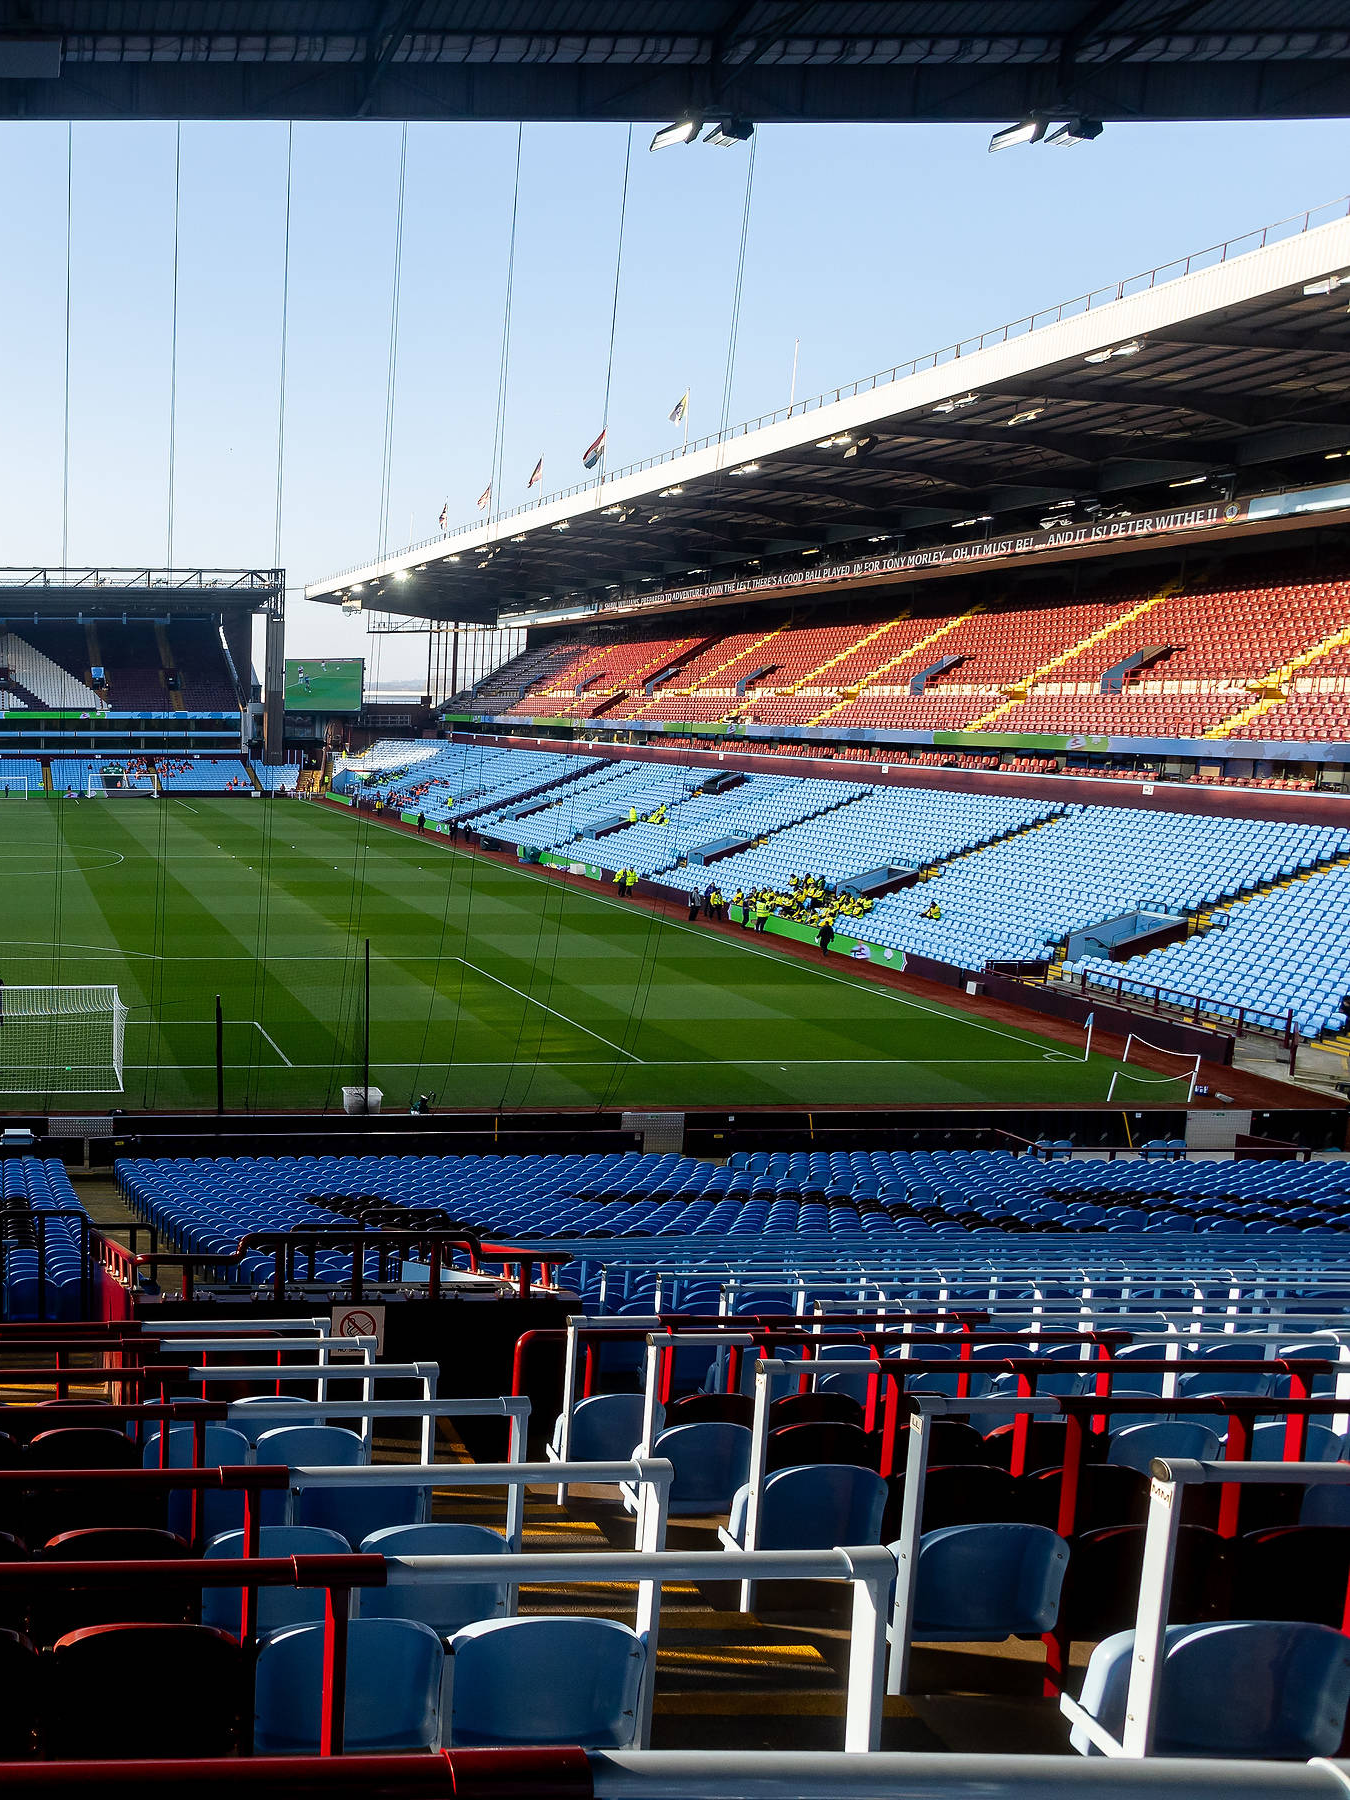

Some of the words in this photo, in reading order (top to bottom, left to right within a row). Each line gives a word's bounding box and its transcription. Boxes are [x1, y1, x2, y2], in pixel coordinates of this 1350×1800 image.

[672, 587, 703, 601] ADVENTURE
[724, 582, 736, 592] THE
[752, 576, 777, 588] THERE'S
[783, 571, 804, 584] GOOD
[805, 569, 822, 581] BALL
[822, 565, 850, 580] PLAYED
[853, 563, 863, 574] IN
[863, 560, 880, 573] FOR
[882, 556, 906, 570] TONY
[970, 545, 982, 558] IT
[983, 540, 1014, 556] MUST
[1015, 537, 1034, 552] BE!
[1075, 528, 1087, 542] IT
[1090, 525, 1108, 539] IS!
[1109, 518, 1153, 537] PETER
[1155, 510, 1205, 530] WITHE
